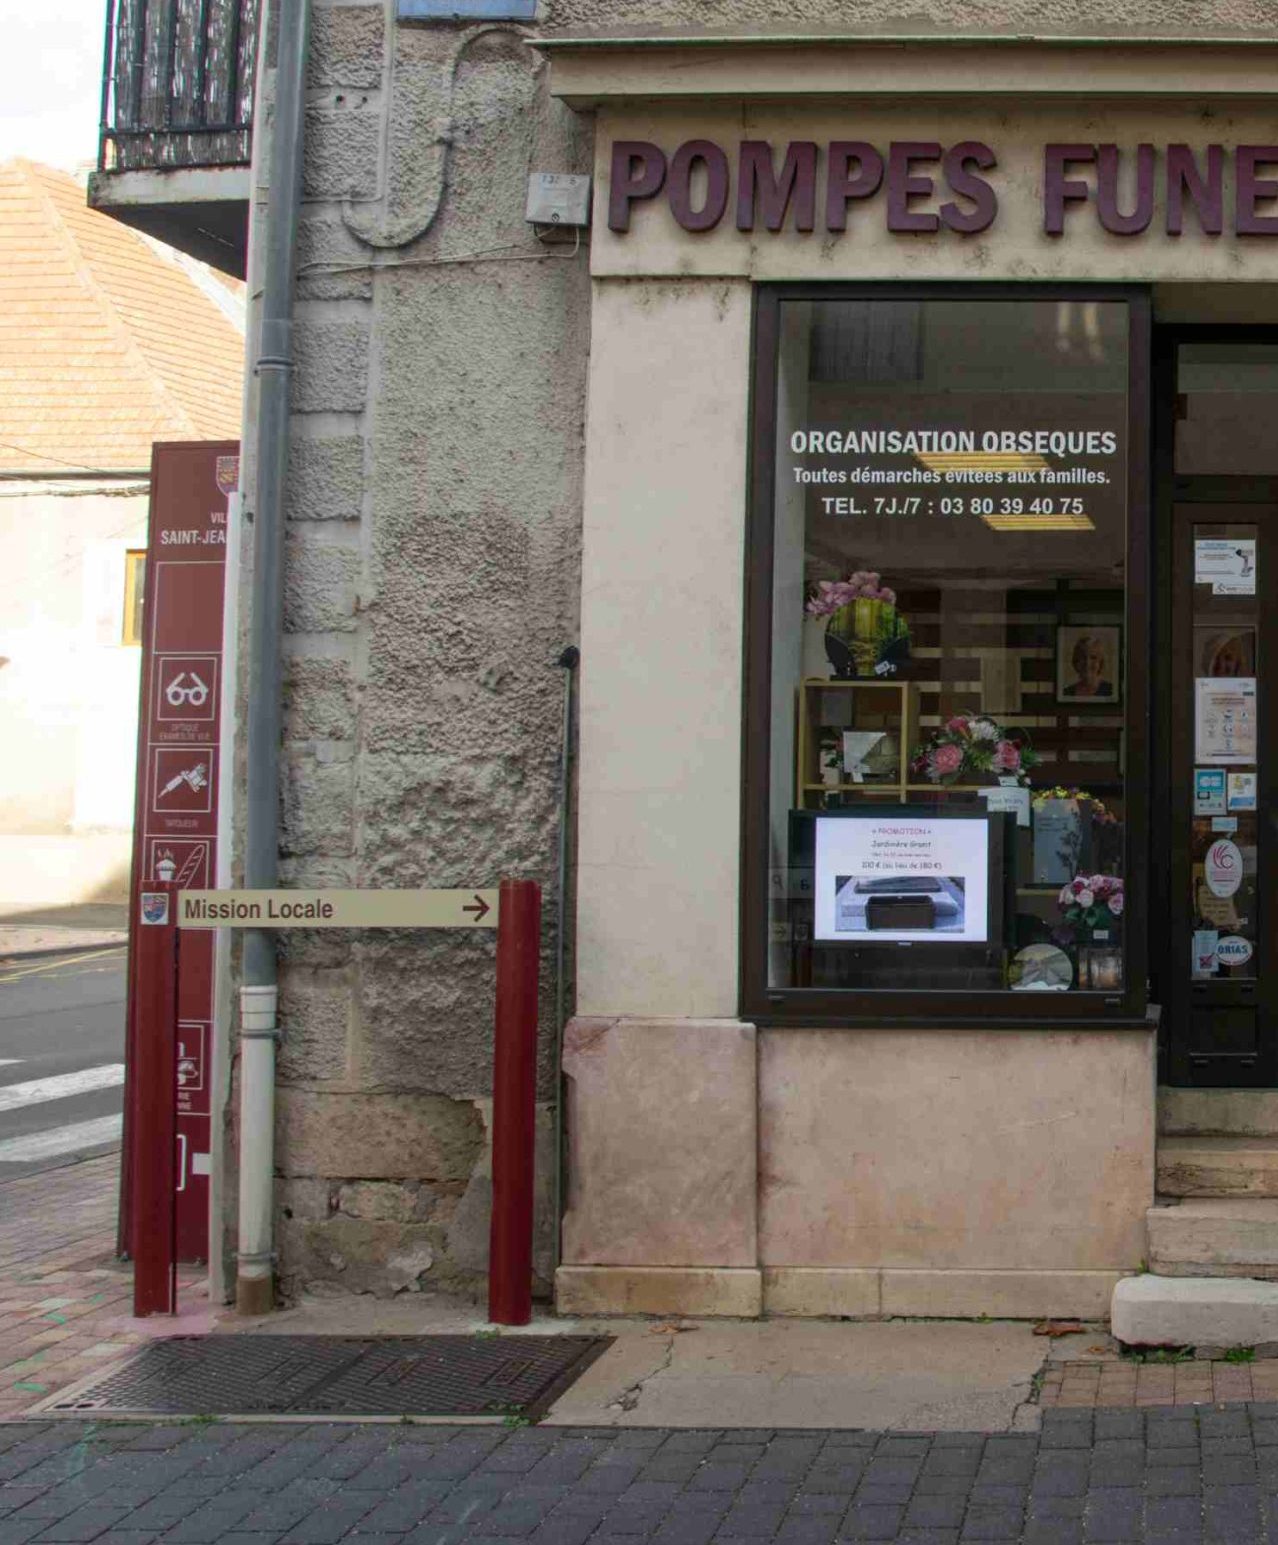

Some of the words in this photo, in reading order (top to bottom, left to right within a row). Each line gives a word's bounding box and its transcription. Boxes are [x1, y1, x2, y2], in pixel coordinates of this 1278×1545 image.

[607, 138, 998, 235] POMPES
[790, 431, 973, 455] ORGANISATION
[982, 431, 1118, 458] OBSEQUES
[793, 467, 847, 484] Toutes
[850, 466, 942, 484] démarches
[1007, 470, 1037, 484] aux
[1039, 467, 1111, 485] familles.
[821, 497, 867, 515] TEL.
[939, 497, 964, 515] 03
[970, 497, 994, 515] 80
[999, 497, 1023, 515] 39
[1029, 497, 1053, 515] 40
[1059, 497, 1084, 515] 75
[184, 898, 261, 919] Mission
[267, 898, 334, 919] Locale
